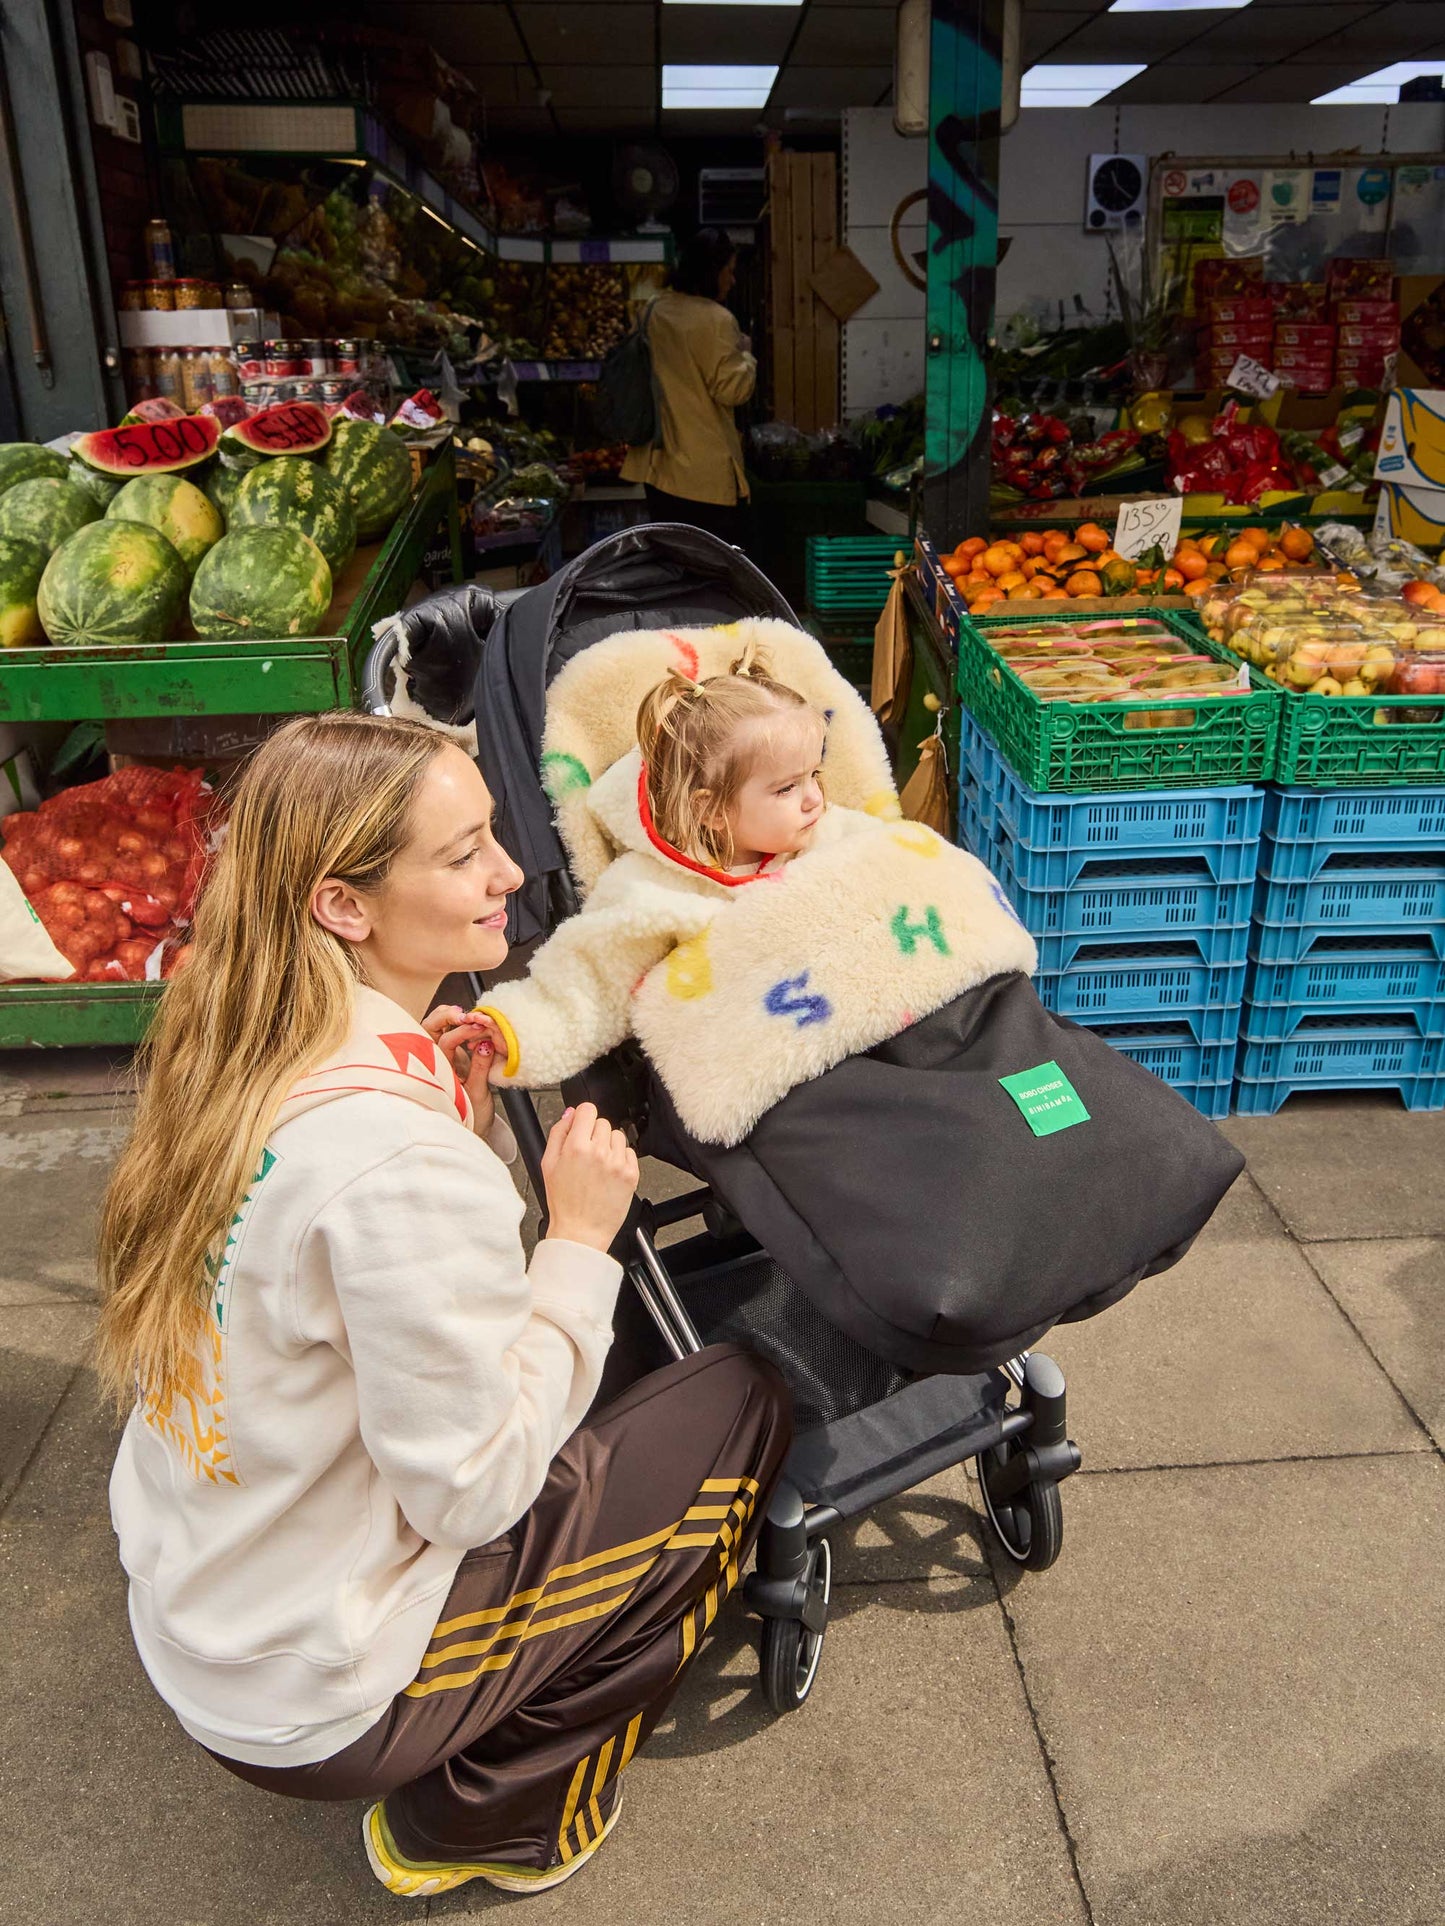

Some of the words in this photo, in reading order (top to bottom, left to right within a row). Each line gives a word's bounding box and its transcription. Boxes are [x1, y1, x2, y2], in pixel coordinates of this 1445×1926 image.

[1018, 1088, 1039, 1100] BOBO
[1037, 1079, 1064, 1095] CHOSES
[1028, 1094, 1073, 1115] BINIBAMBA
